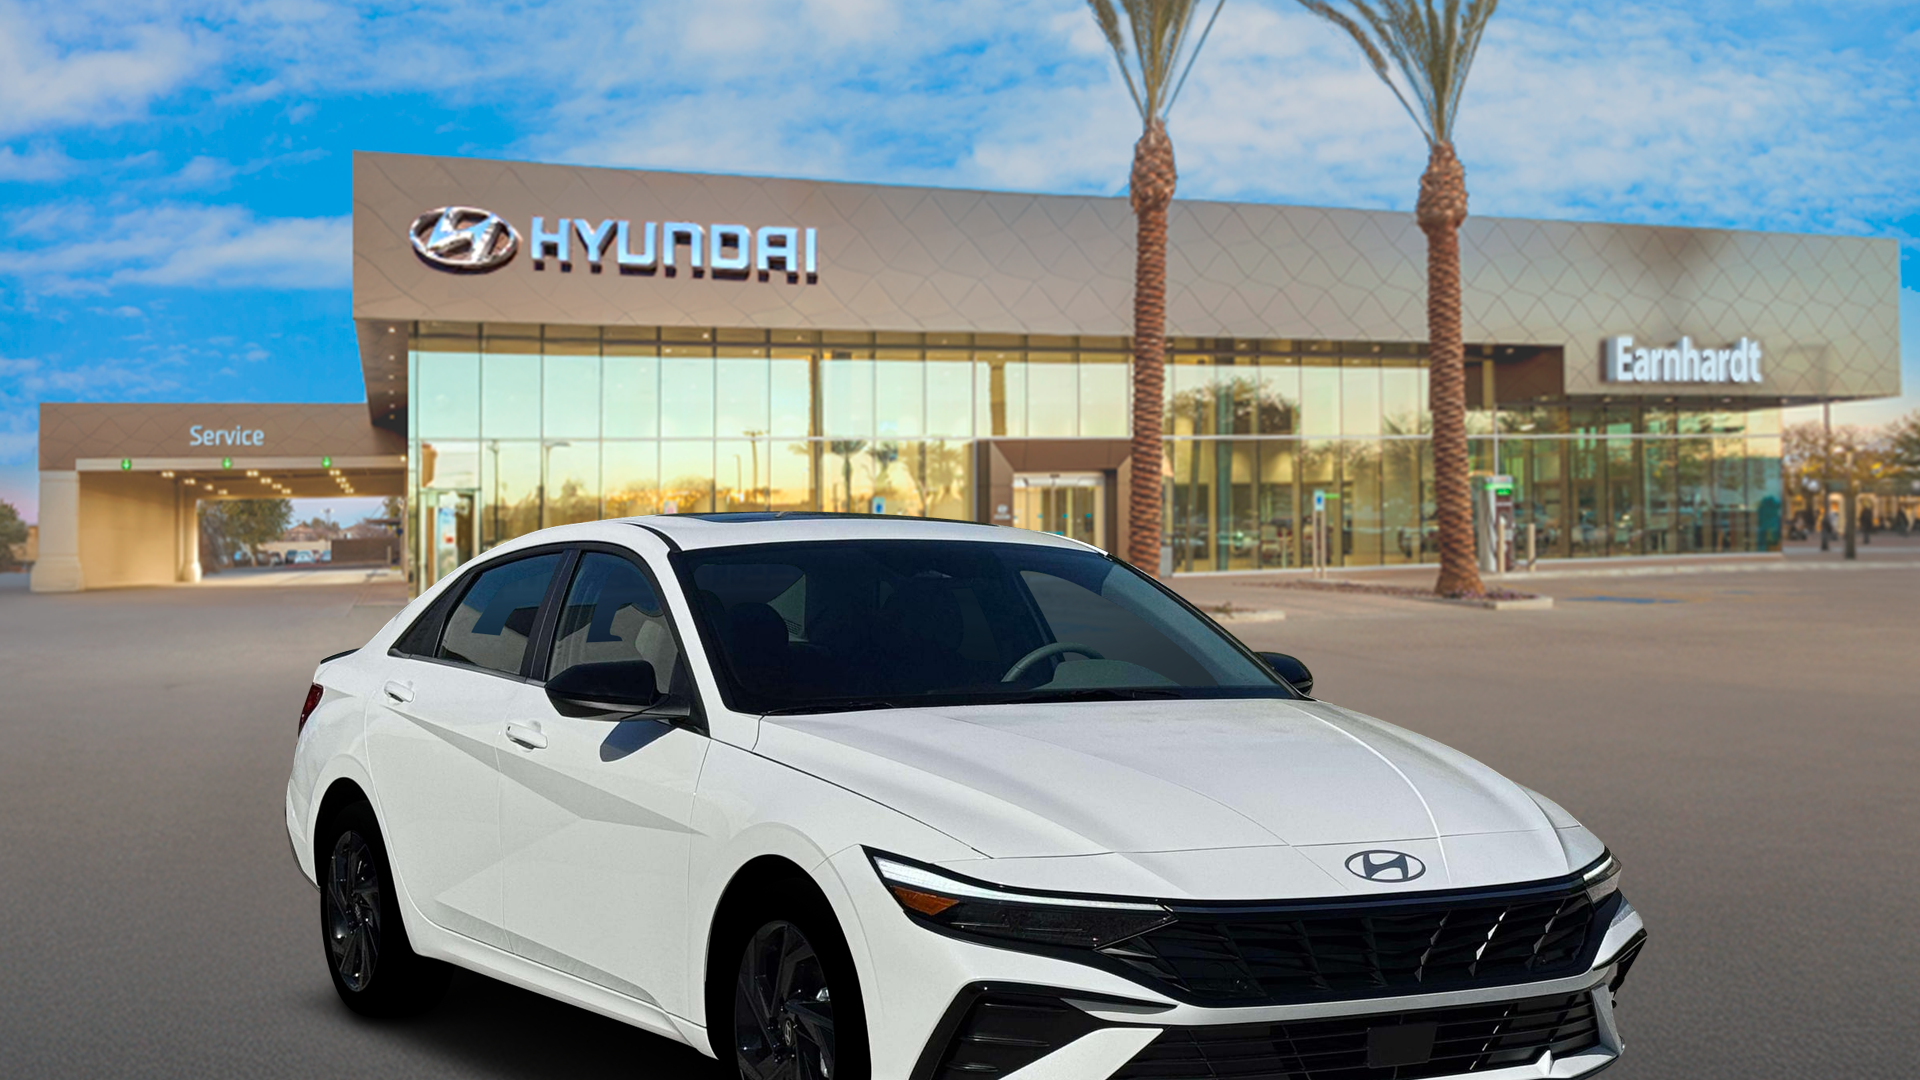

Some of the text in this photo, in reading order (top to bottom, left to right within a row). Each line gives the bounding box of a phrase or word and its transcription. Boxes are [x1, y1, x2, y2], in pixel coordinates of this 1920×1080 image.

[531, 216, 818, 276] HYUNDAI
[1615, 335, 1762, 382] Earnhardt
[189, 425, 265, 446] Service
